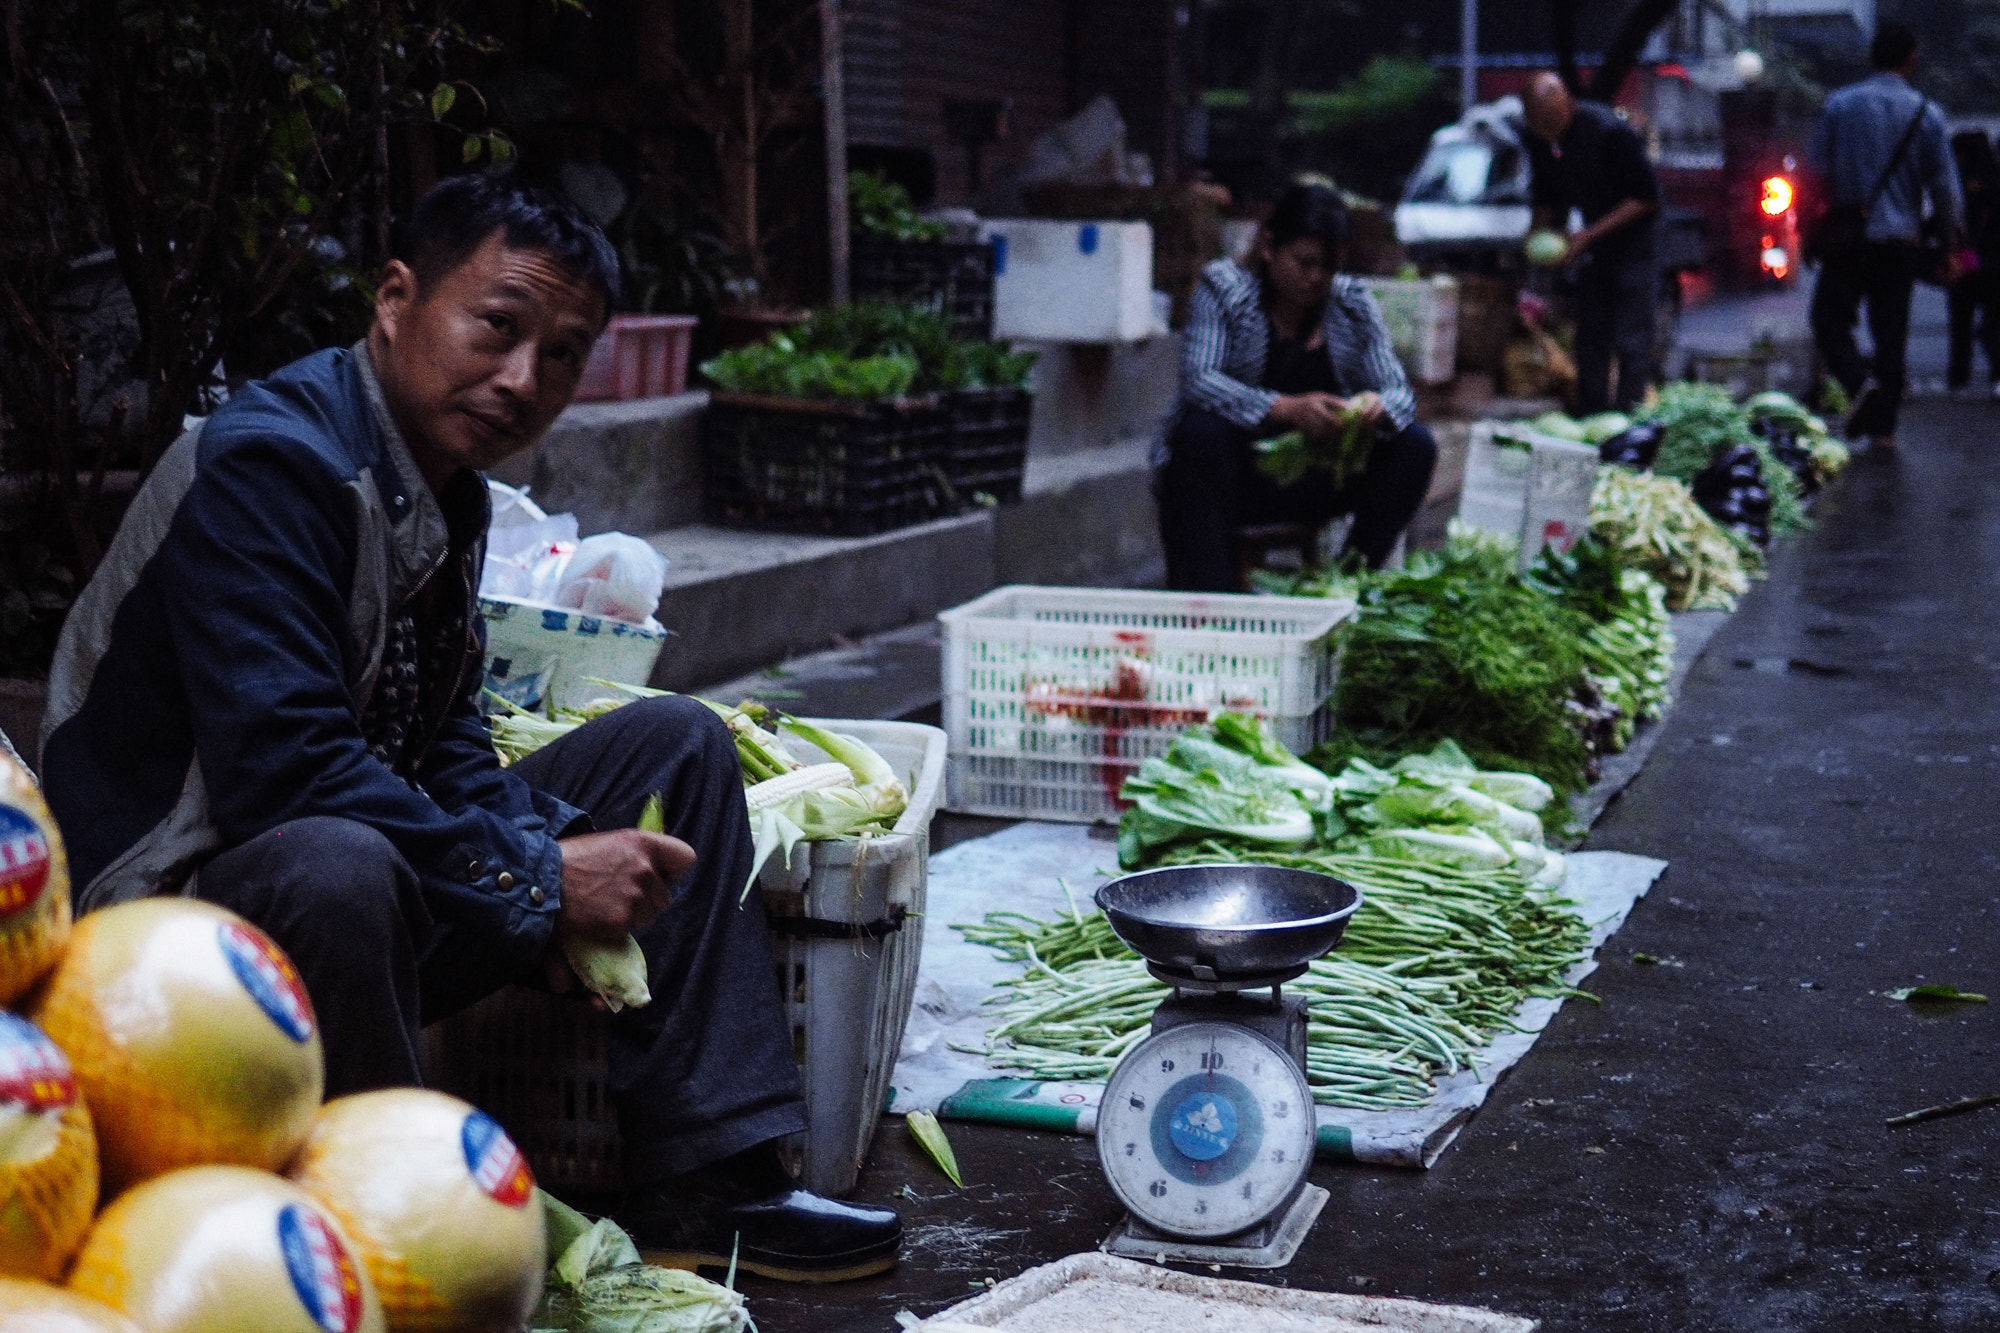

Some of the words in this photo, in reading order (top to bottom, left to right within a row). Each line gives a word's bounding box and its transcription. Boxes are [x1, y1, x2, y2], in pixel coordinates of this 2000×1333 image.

[1161, 1059, 1175, 1073] 9
[1201, 1052, 1224, 1069] 10
[1271, 1149, 1285, 1164] 3
[1149, 1180, 1168, 1198] 6
[1194, 1199, 1207, 1214] 5
